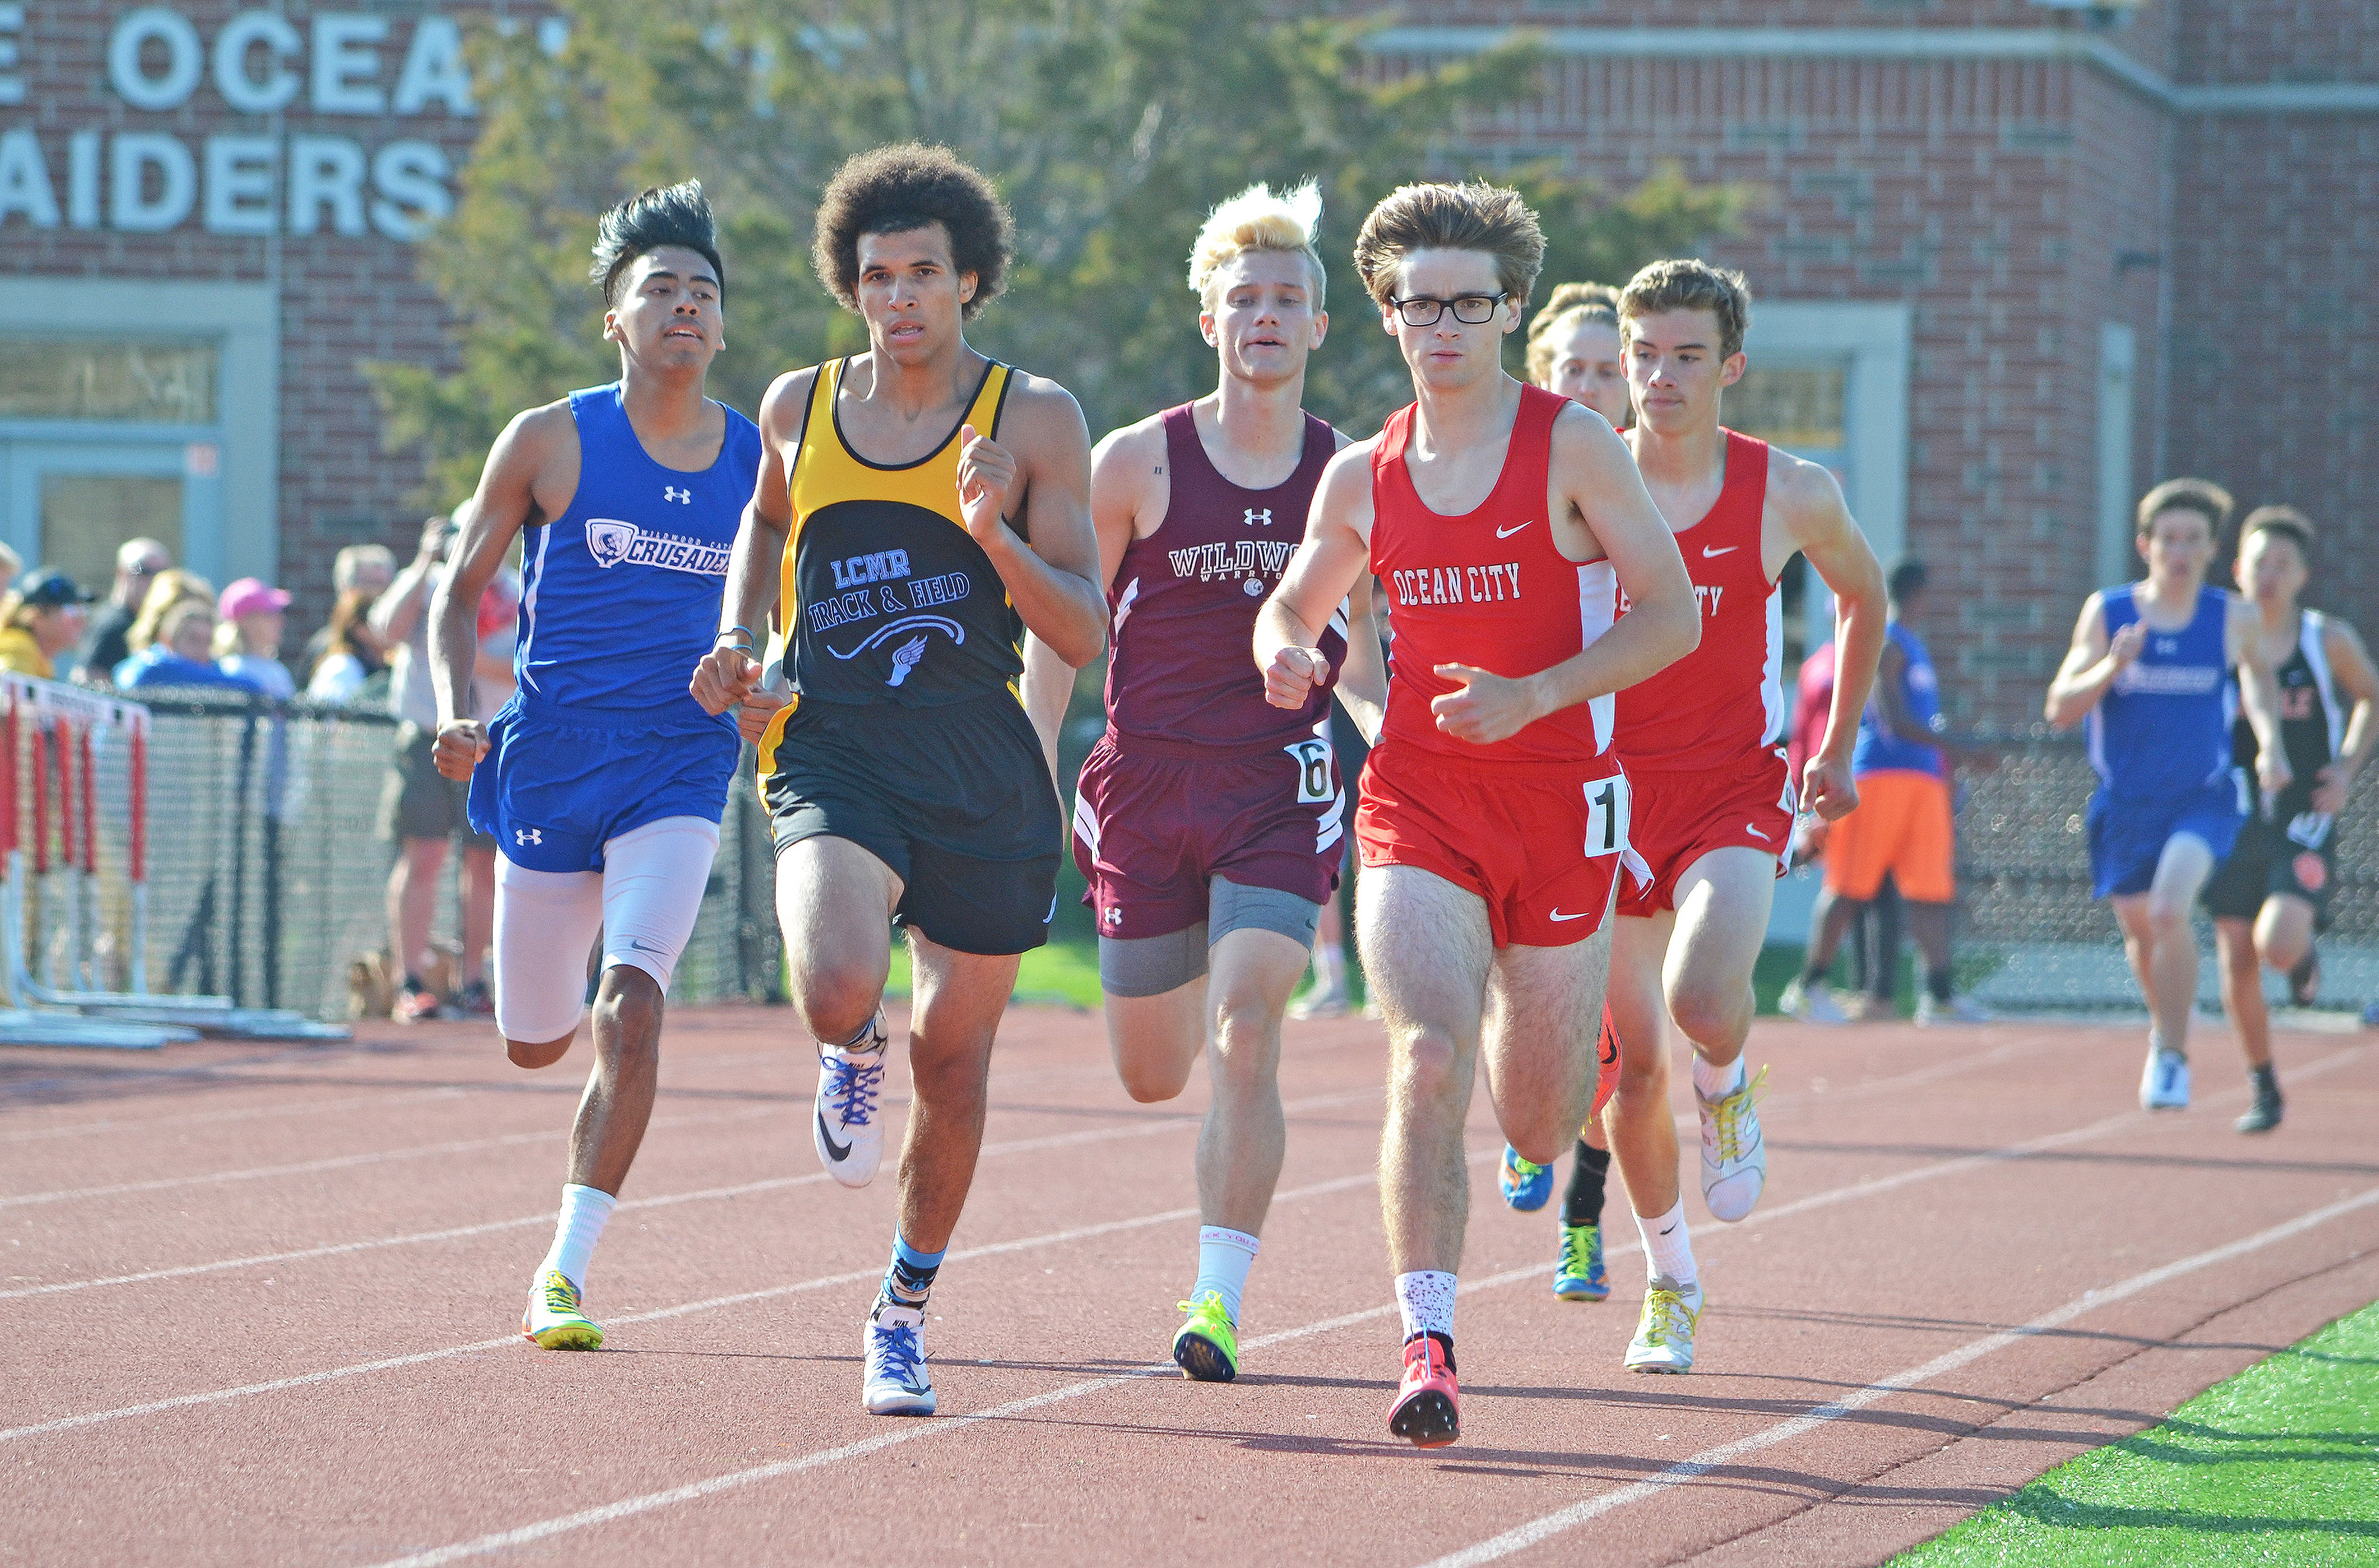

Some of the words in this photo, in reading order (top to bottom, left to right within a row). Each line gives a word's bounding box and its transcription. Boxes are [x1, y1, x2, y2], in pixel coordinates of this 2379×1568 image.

[830, 548, 911, 590] LCMR
[1393, 566, 1464, 606] OCEAN
[1467, 562, 1521, 602] CITY
[808, 590, 878, 633] TRACK
[880, 585, 906, 613] &
[907, 572, 970, 609] FIELD
[1299, 743, 1327, 797] 6
[1594, 781, 1615, 849] 1
